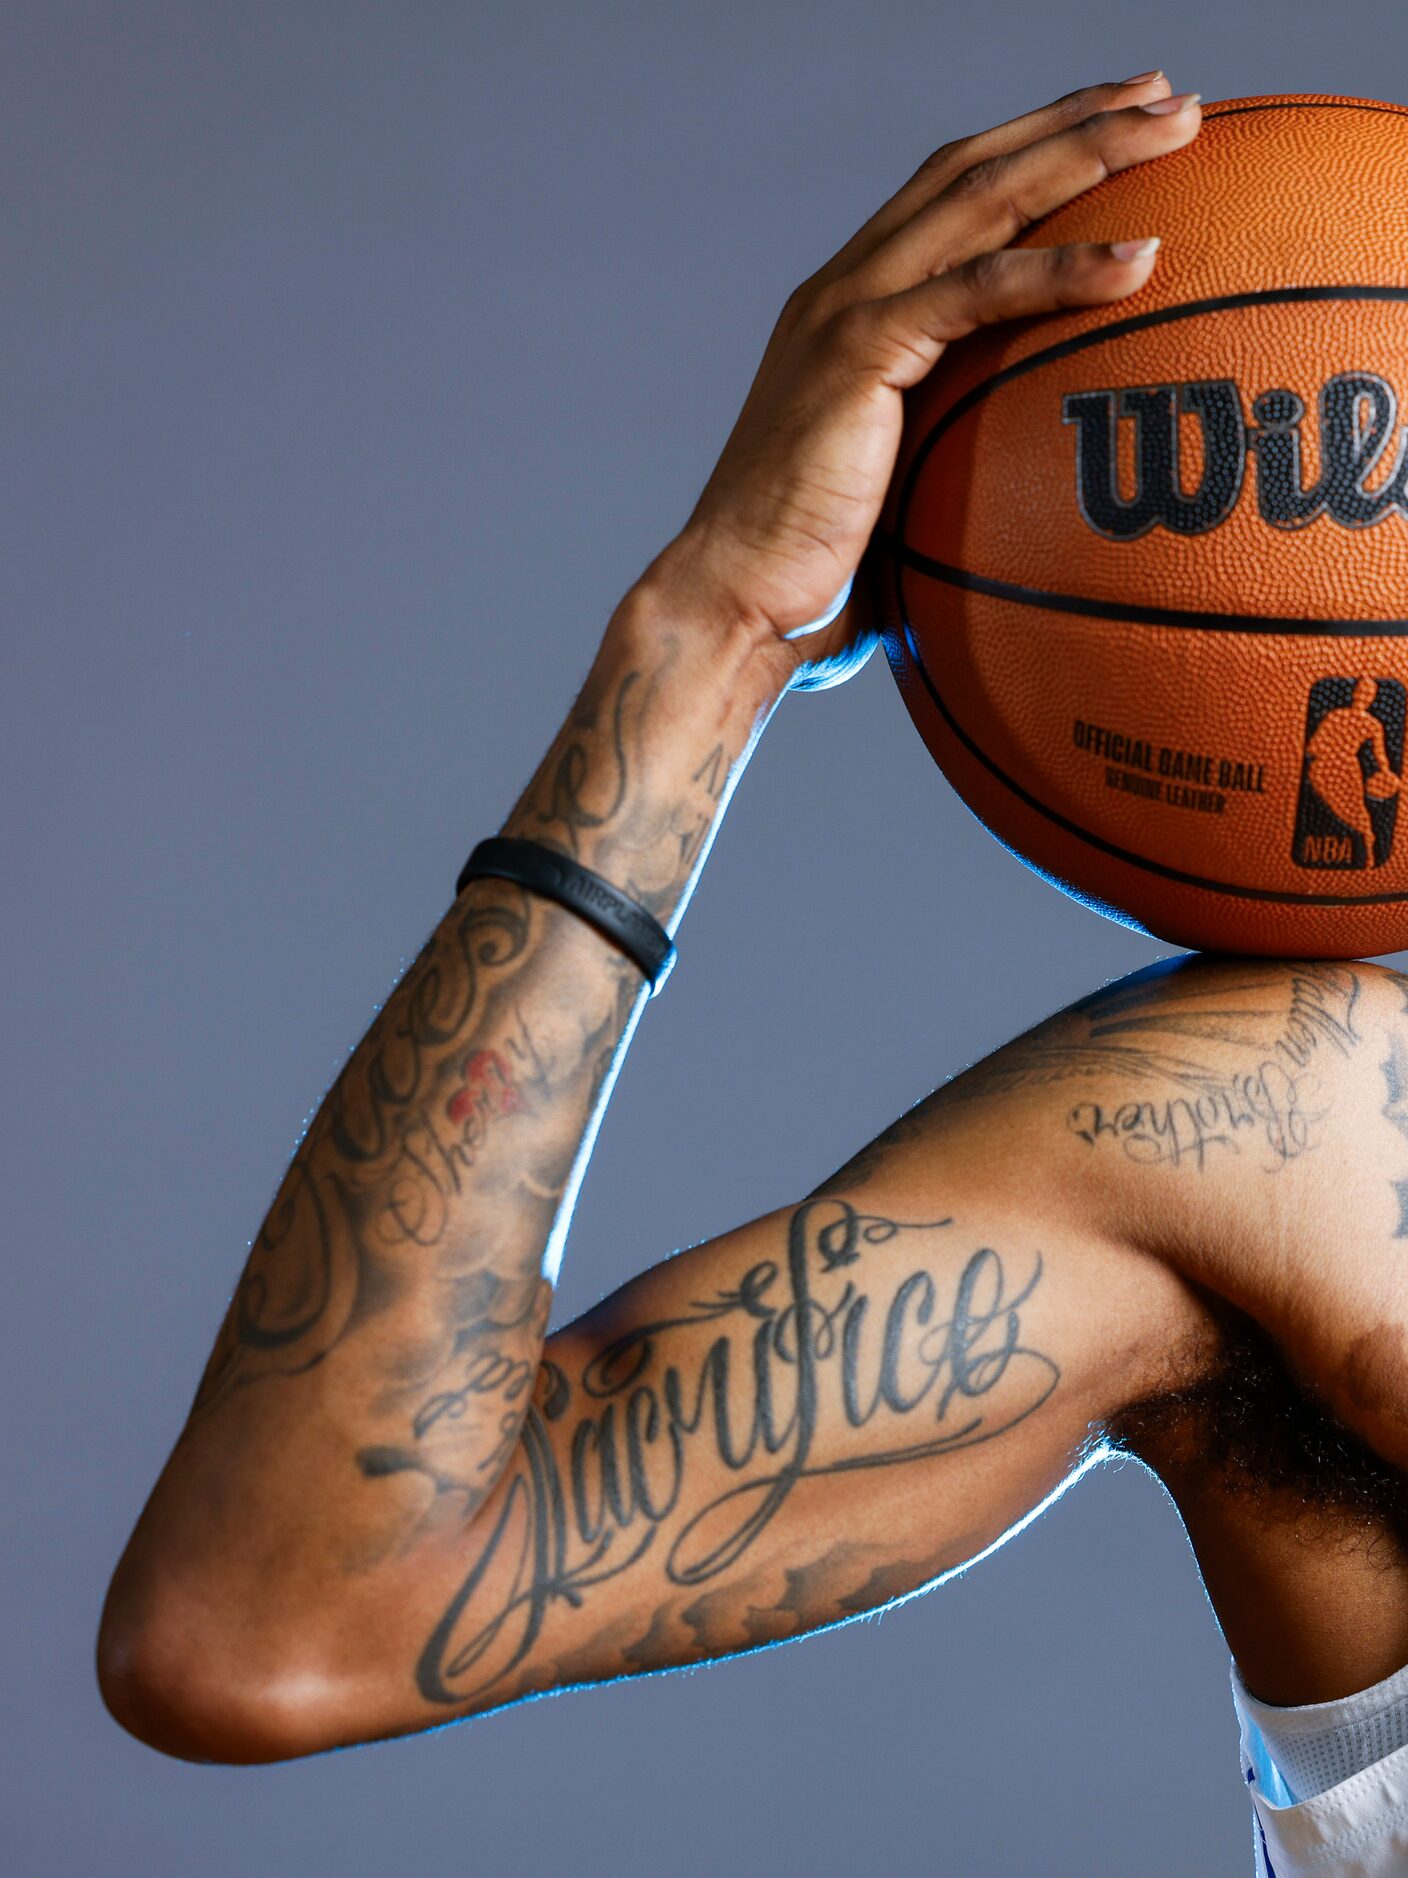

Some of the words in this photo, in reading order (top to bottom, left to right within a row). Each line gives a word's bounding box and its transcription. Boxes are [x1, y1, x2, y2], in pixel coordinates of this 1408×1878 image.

[1073, 719, 1154, 772] OFFICIAL
[1158, 748, 1213, 785] GAME
[1217, 759, 1266, 793] BALL
[1303, 834, 1353, 863] NBA
[416, 1200, 1060, 1702] Sacrifice
